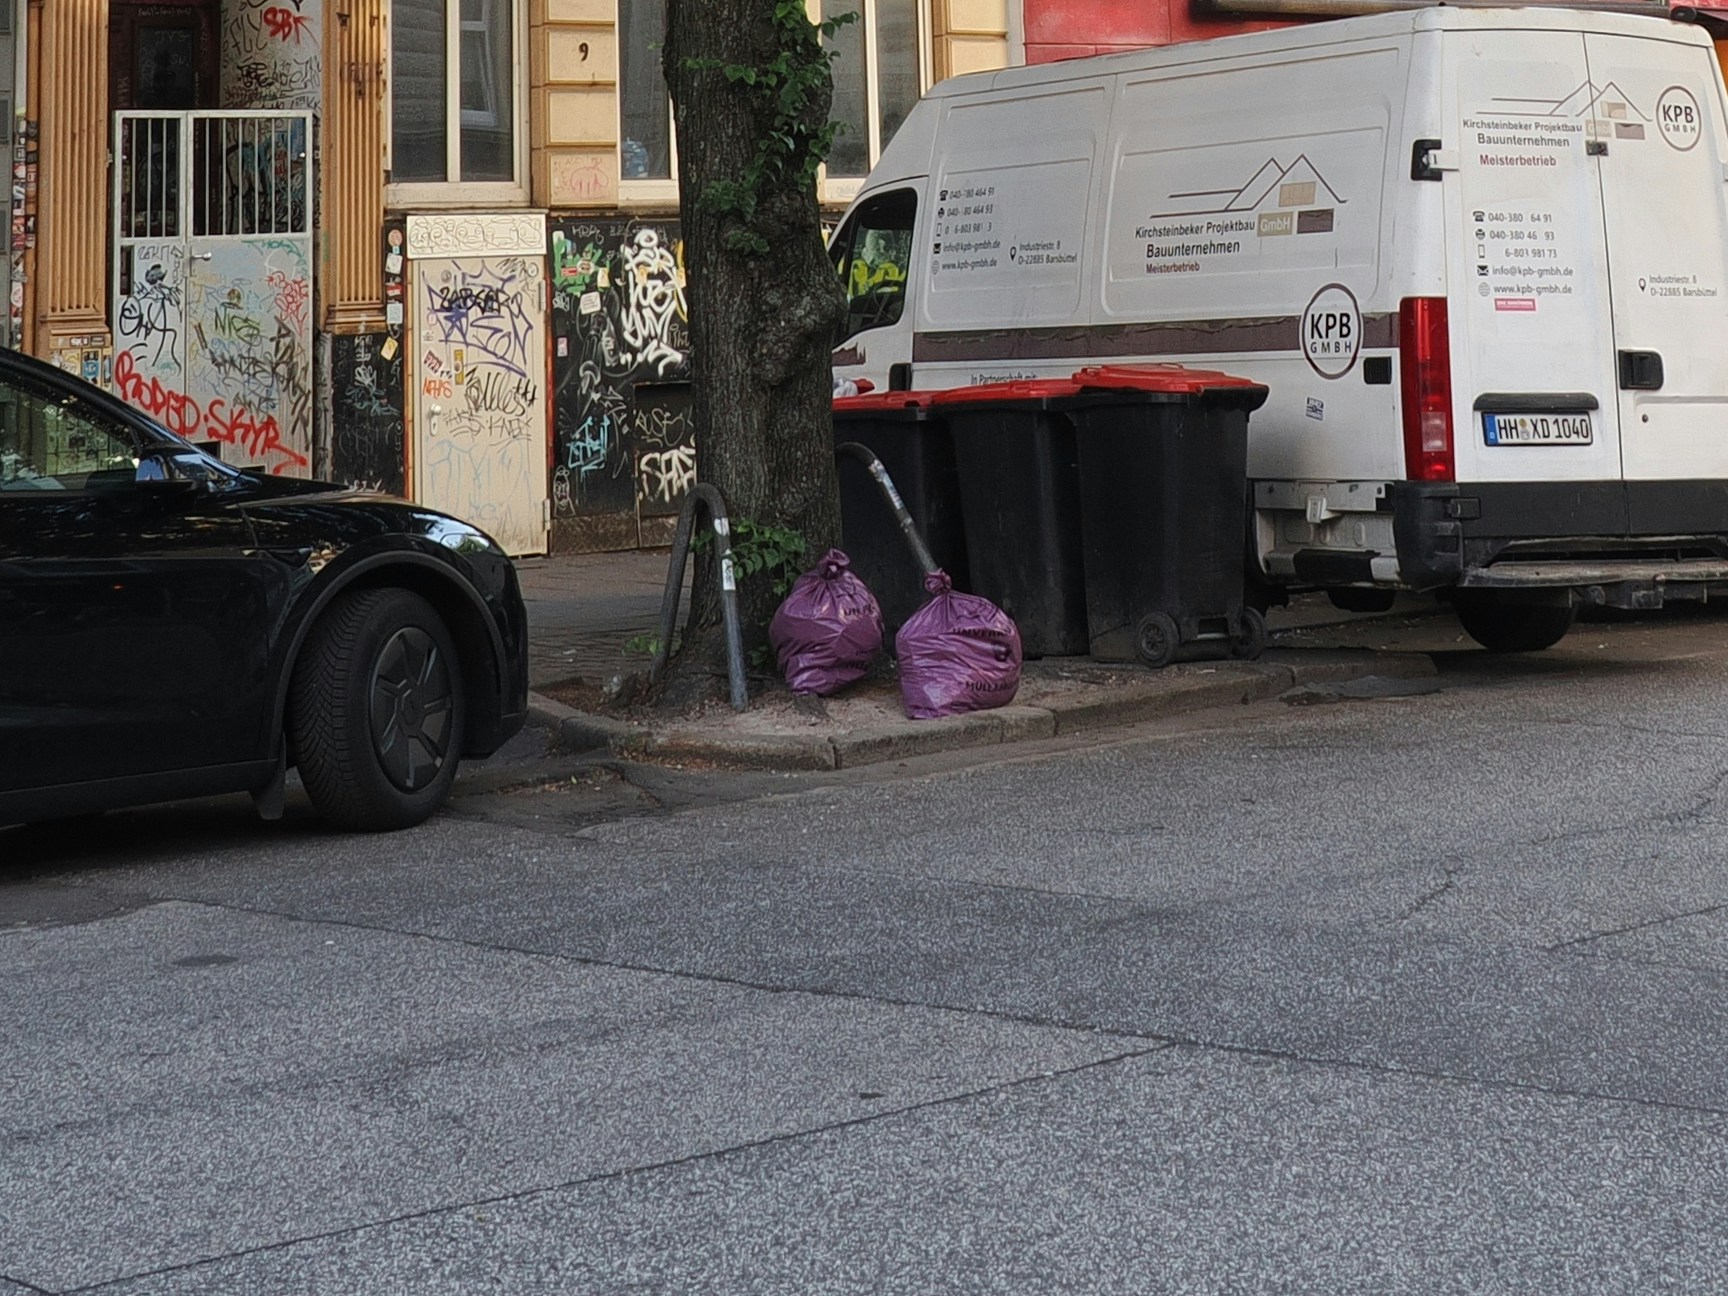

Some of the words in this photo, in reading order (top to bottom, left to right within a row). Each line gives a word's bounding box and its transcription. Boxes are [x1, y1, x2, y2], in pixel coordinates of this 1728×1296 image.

[578, 41, 589, 62] 9
[1663, 105, 1695, 123] KPB
[1463, 119, 1532, 132] Kirchsteinbeker
[1535, 121, 1582, 134] Projektbau
[1477, 133, 1570, 148] Bauunternehmen
[1480, 154, 1557, 167] Meisterbetrieb
[1135, 223, 1204, 239] Kirchsteinbeker
[1206, 219, 1255, 236] Projektbau
[1260, 217, 1291, 233] GmbH
[1146, 240, 1240, 258] Bauunternehmen
[1146, 262, 1200, 274] Meisterbetrieb
[1492, 265, 1574, 278] info@kpb-gmbh.de
[1493, 284, 1573, 296] www.kpb-gmbh.de
[1310, 312, 1352, 339] KPB
[1497, 417, 1520, 440] HH
[1530, 417, 1551, 440] XD
[1553, 418, 1590, 439] 1040
